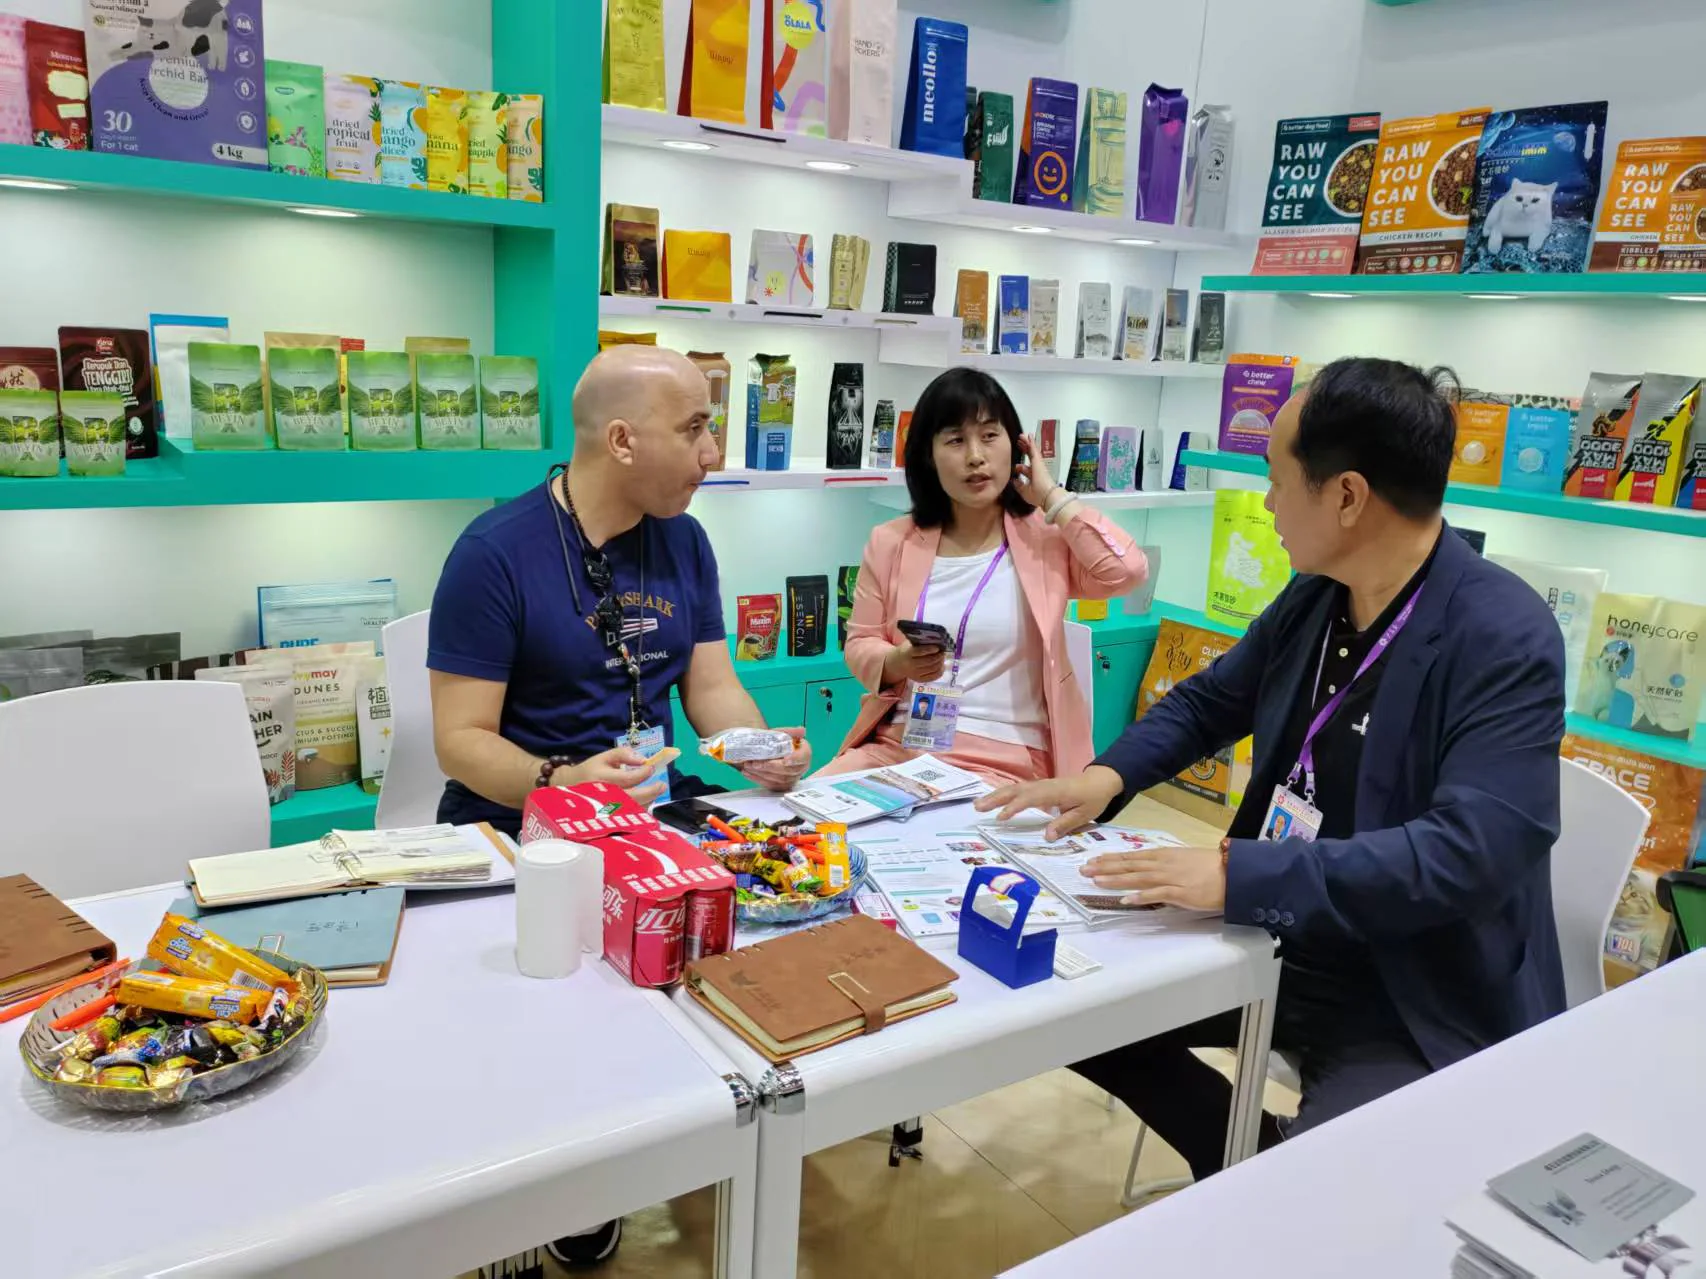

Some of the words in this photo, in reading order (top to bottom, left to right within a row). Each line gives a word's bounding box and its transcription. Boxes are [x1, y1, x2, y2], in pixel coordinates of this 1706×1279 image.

[102, 110, 133, 133] 30
[332, 119, 360, 129] dried
[101, 140, 115, 149] For
[124, 142, 139, 151] cat
[335, 138, 358, 148] fruit
[216, 145, 224, 155] 4
[227, 145, 244, 159] kg
[1280, 142, 1327, 161] RAW
[1383, 141, 1431, 163] RAW
[1278, 164, 1321, 181] YOU
[1379, 164, 1423, 184] YOU
[1625, 162, 1670, 177] RAW
[1272, 184, 1316, 200] CAN
[1621, 180, 1663, 193] YOU
[1373, 186, 1418, 205] CAN
[1615, 197, 1657, 210] CAN
[1670, 203, 1695, 212] RAW
[1268, 203, 1305, 221] SEE
[1368, 208, 1406, 227] SEE
[1668, 213, 1692, 222] YOU
[1610, 213, 1647, 227] SEE
[1666, 223, 1690, 232] CAN
[1663, 233, 1685, 242] SEE
[84, 369, 131, 386] TENGGIRI
[1250, 371, 1275, 380] better
[1580, 440, 1623, 453] 3000
[1582, 450, 1615, 463] MAX
[1633, 455, 1667, 467] MAX
[1607, 614, 1699, 642] honeycare
[294, 683, 340, 695] DUNES
[254, 724, 283, 740] HER
